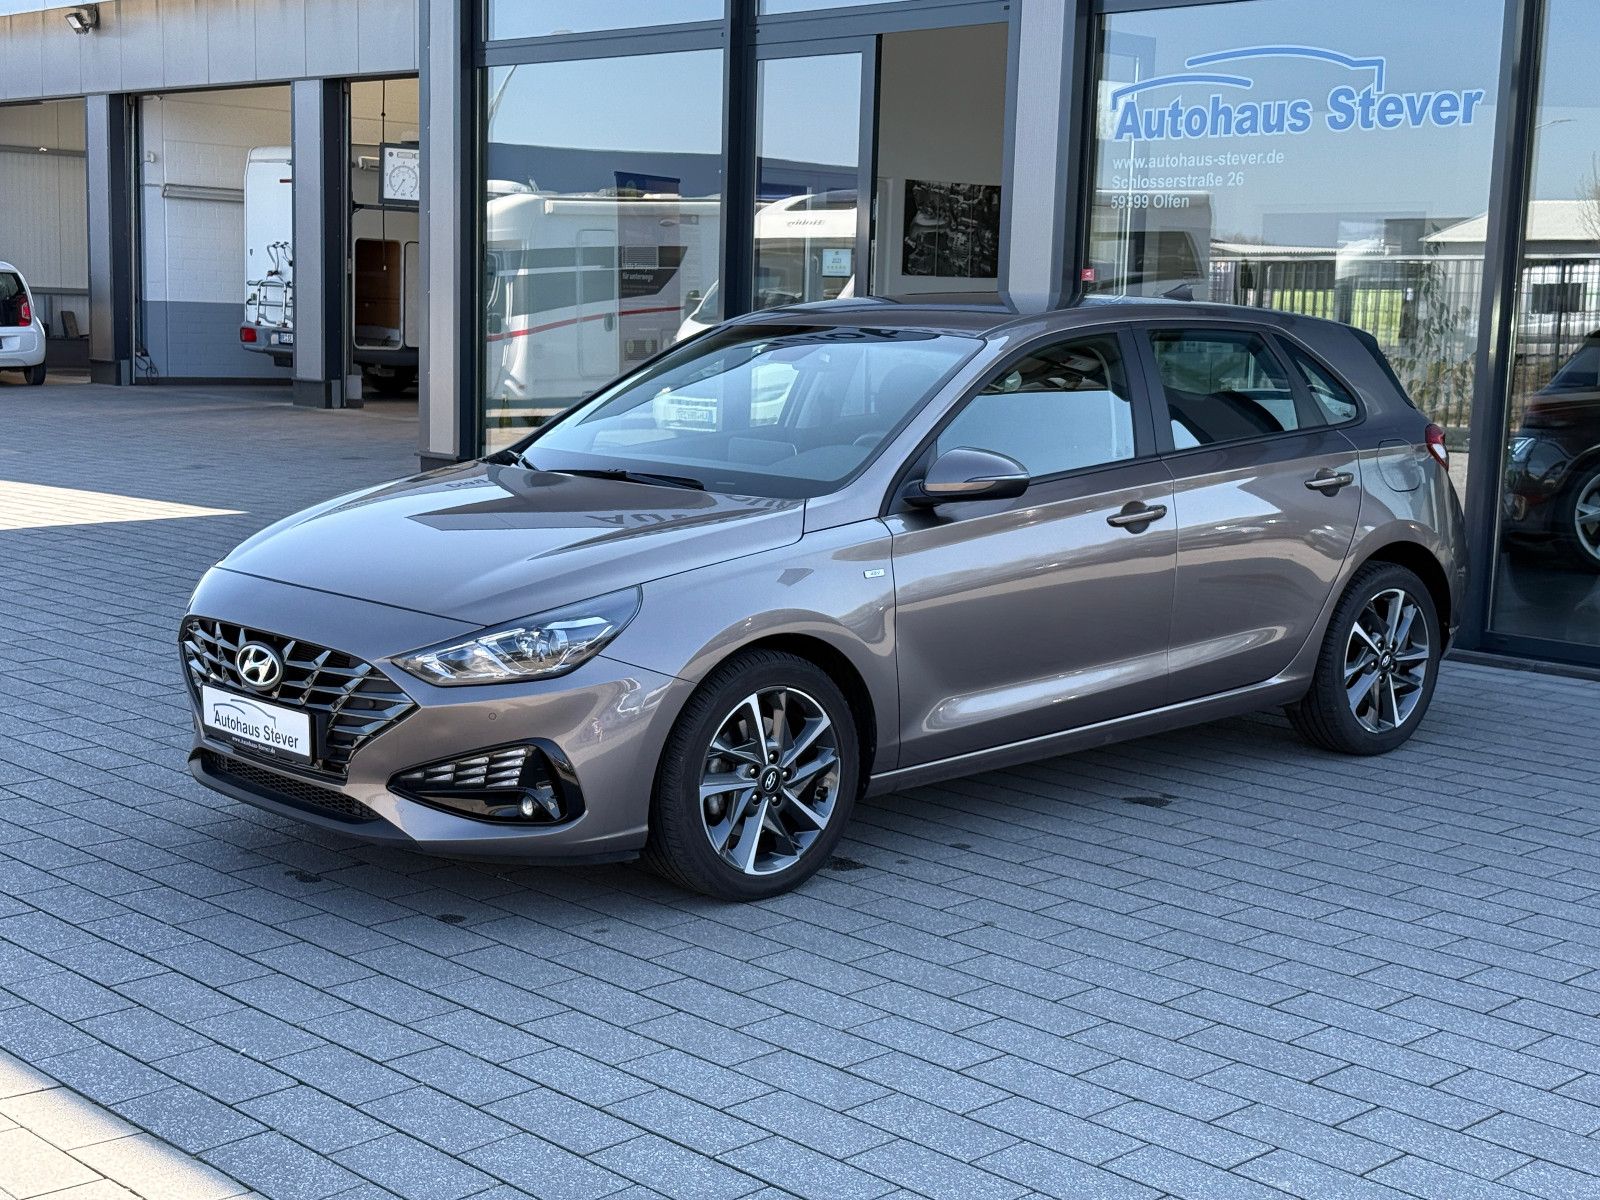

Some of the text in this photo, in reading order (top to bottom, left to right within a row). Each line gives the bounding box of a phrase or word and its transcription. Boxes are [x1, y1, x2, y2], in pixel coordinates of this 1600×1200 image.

[1113, 83, 1485, 141] Autohaus Stever
[1112, 150, 1285, 169] www.autohaus-stever.de
[1111, 172, 1244, 189] Schlosserstraße 26
[1110, 194, 1190, 209] 59399 Olfen
[214, 709, 299, 749] Autohaus Stever
